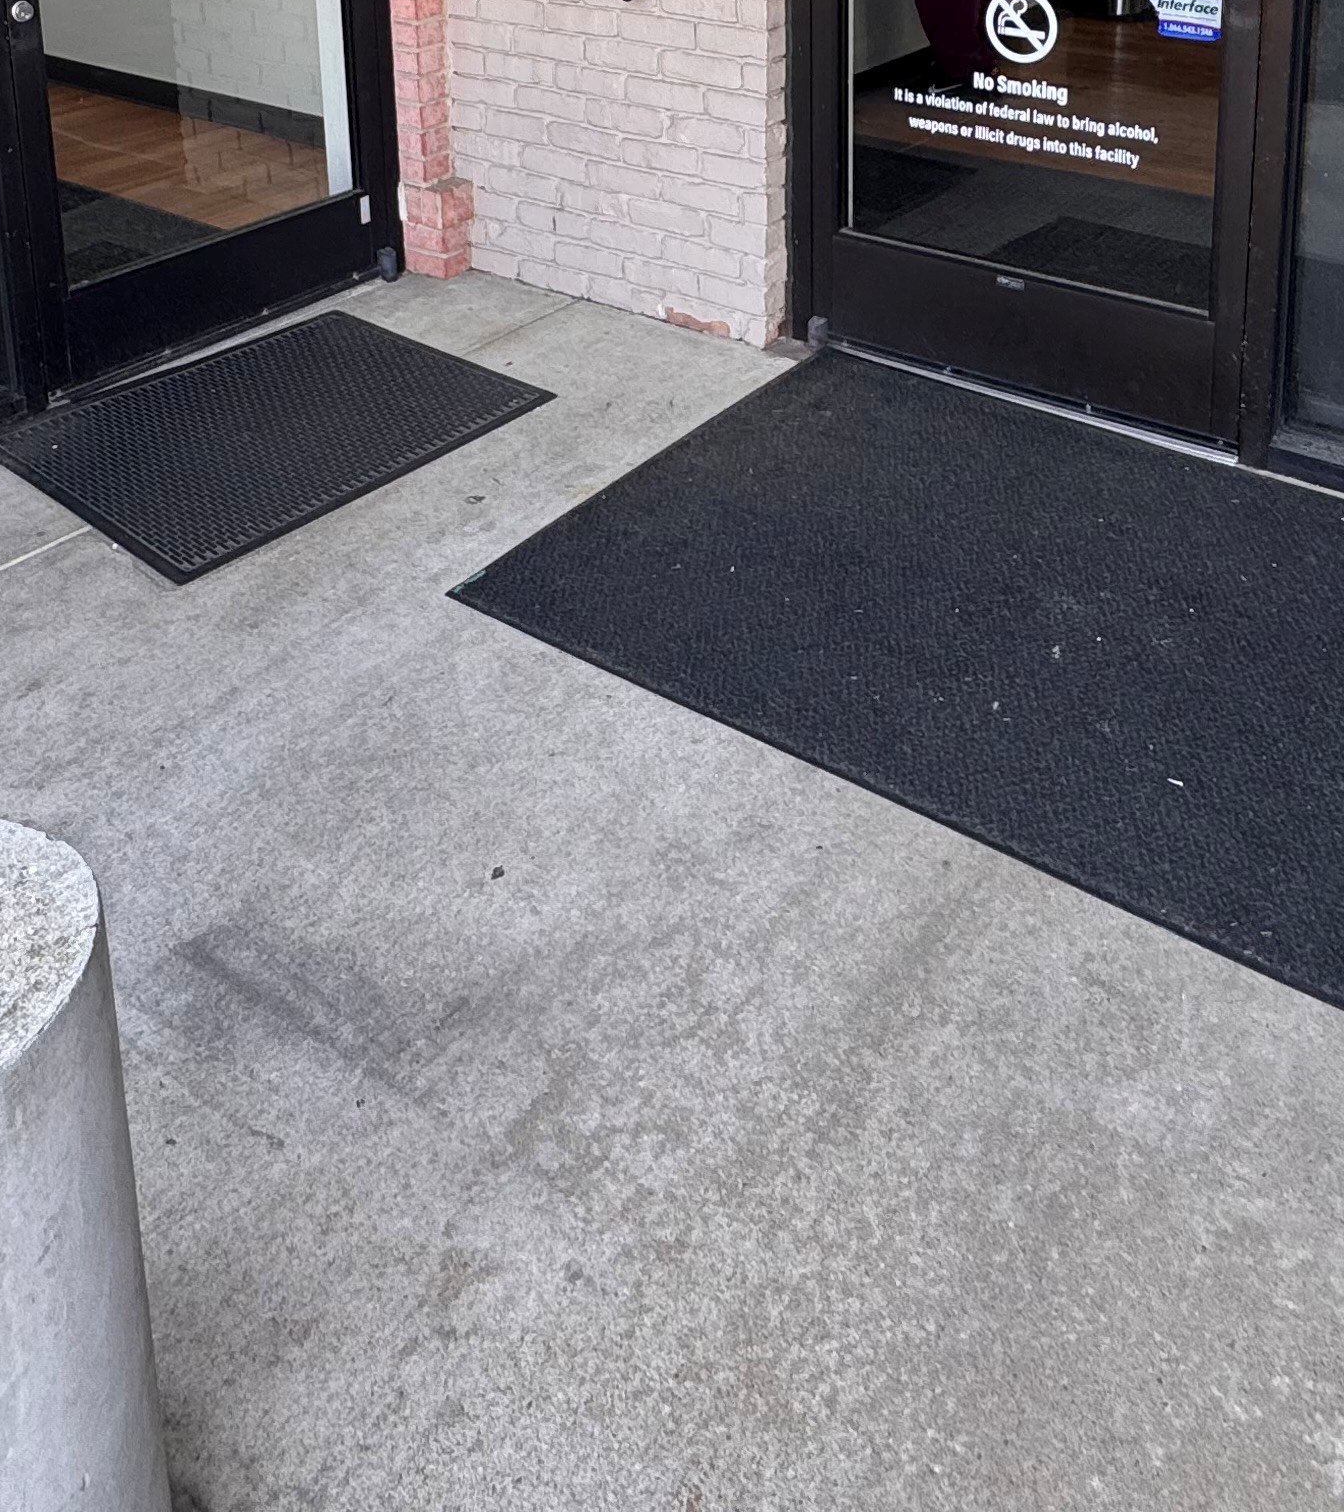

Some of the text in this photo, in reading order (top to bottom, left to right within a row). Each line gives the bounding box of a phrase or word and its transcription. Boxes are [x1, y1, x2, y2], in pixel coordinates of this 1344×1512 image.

[973, 71, 1068, 106] No Smoking
[894, 87, 1158, 144] It is a violation of federal law to bring alcohol,
[909, 117, 1139, 169] weapons or illicit drugs into this facility
